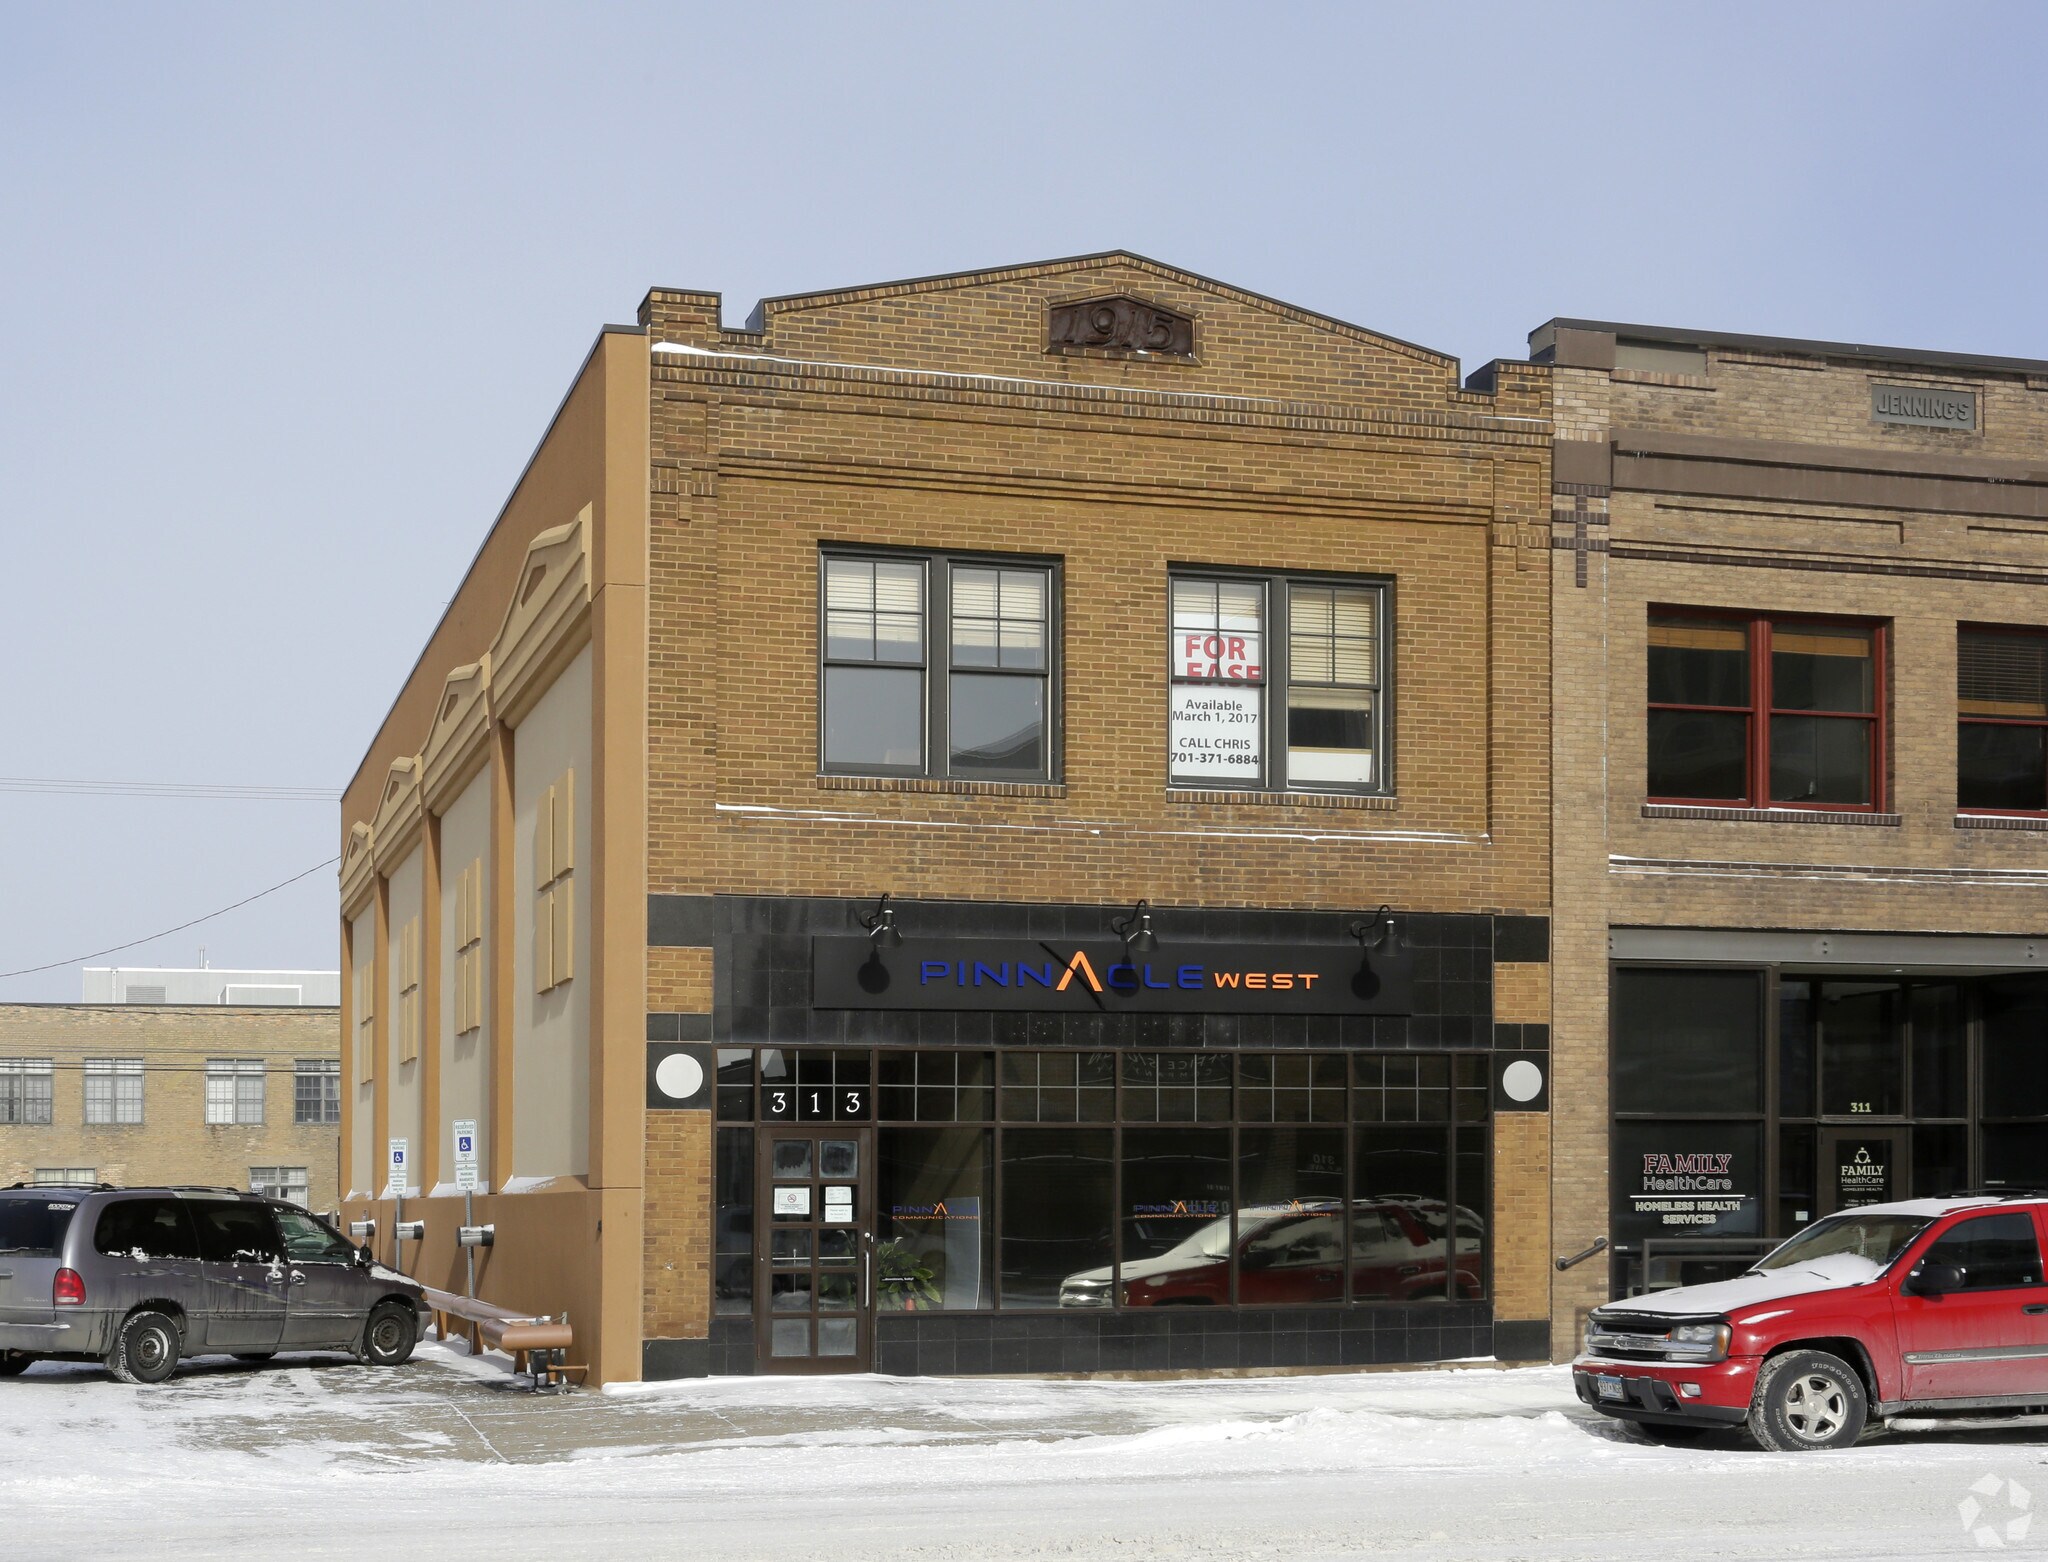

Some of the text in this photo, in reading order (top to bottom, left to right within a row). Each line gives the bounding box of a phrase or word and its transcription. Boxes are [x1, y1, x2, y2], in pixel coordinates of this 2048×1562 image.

[1064, 306, 1175, 350] 1915
[1877, 394, 1969, 421] JENNINGS
[1185, 635, 1246, 661] FOR
[1173, 662, 1261, 688] EASE
[1185, 699, 1243, 711] Available
[1172, 711, 1257, 724] March 1, 2017
[1179, 738, 1251, 750] CALL CHRIS
[1171, 752, 1259, 765] 701-371-6884
[920, 950, 1319, 992] PINNACLE WEST
[1850, 1102, 1872, 1113] 311
[1643, 1154, 1733, 1174] FAMILY
[1841, 1165, 1884, 1176] FAMILY
[1643, 1176, 1733, 1191] HealthCare
[1841, 1176, 1885, 1184] HealthCare
[1635, 1201, 1741, 1212] HOMELESS HEALTH
[1662, 1214, 1717, 1224] SERVICES
